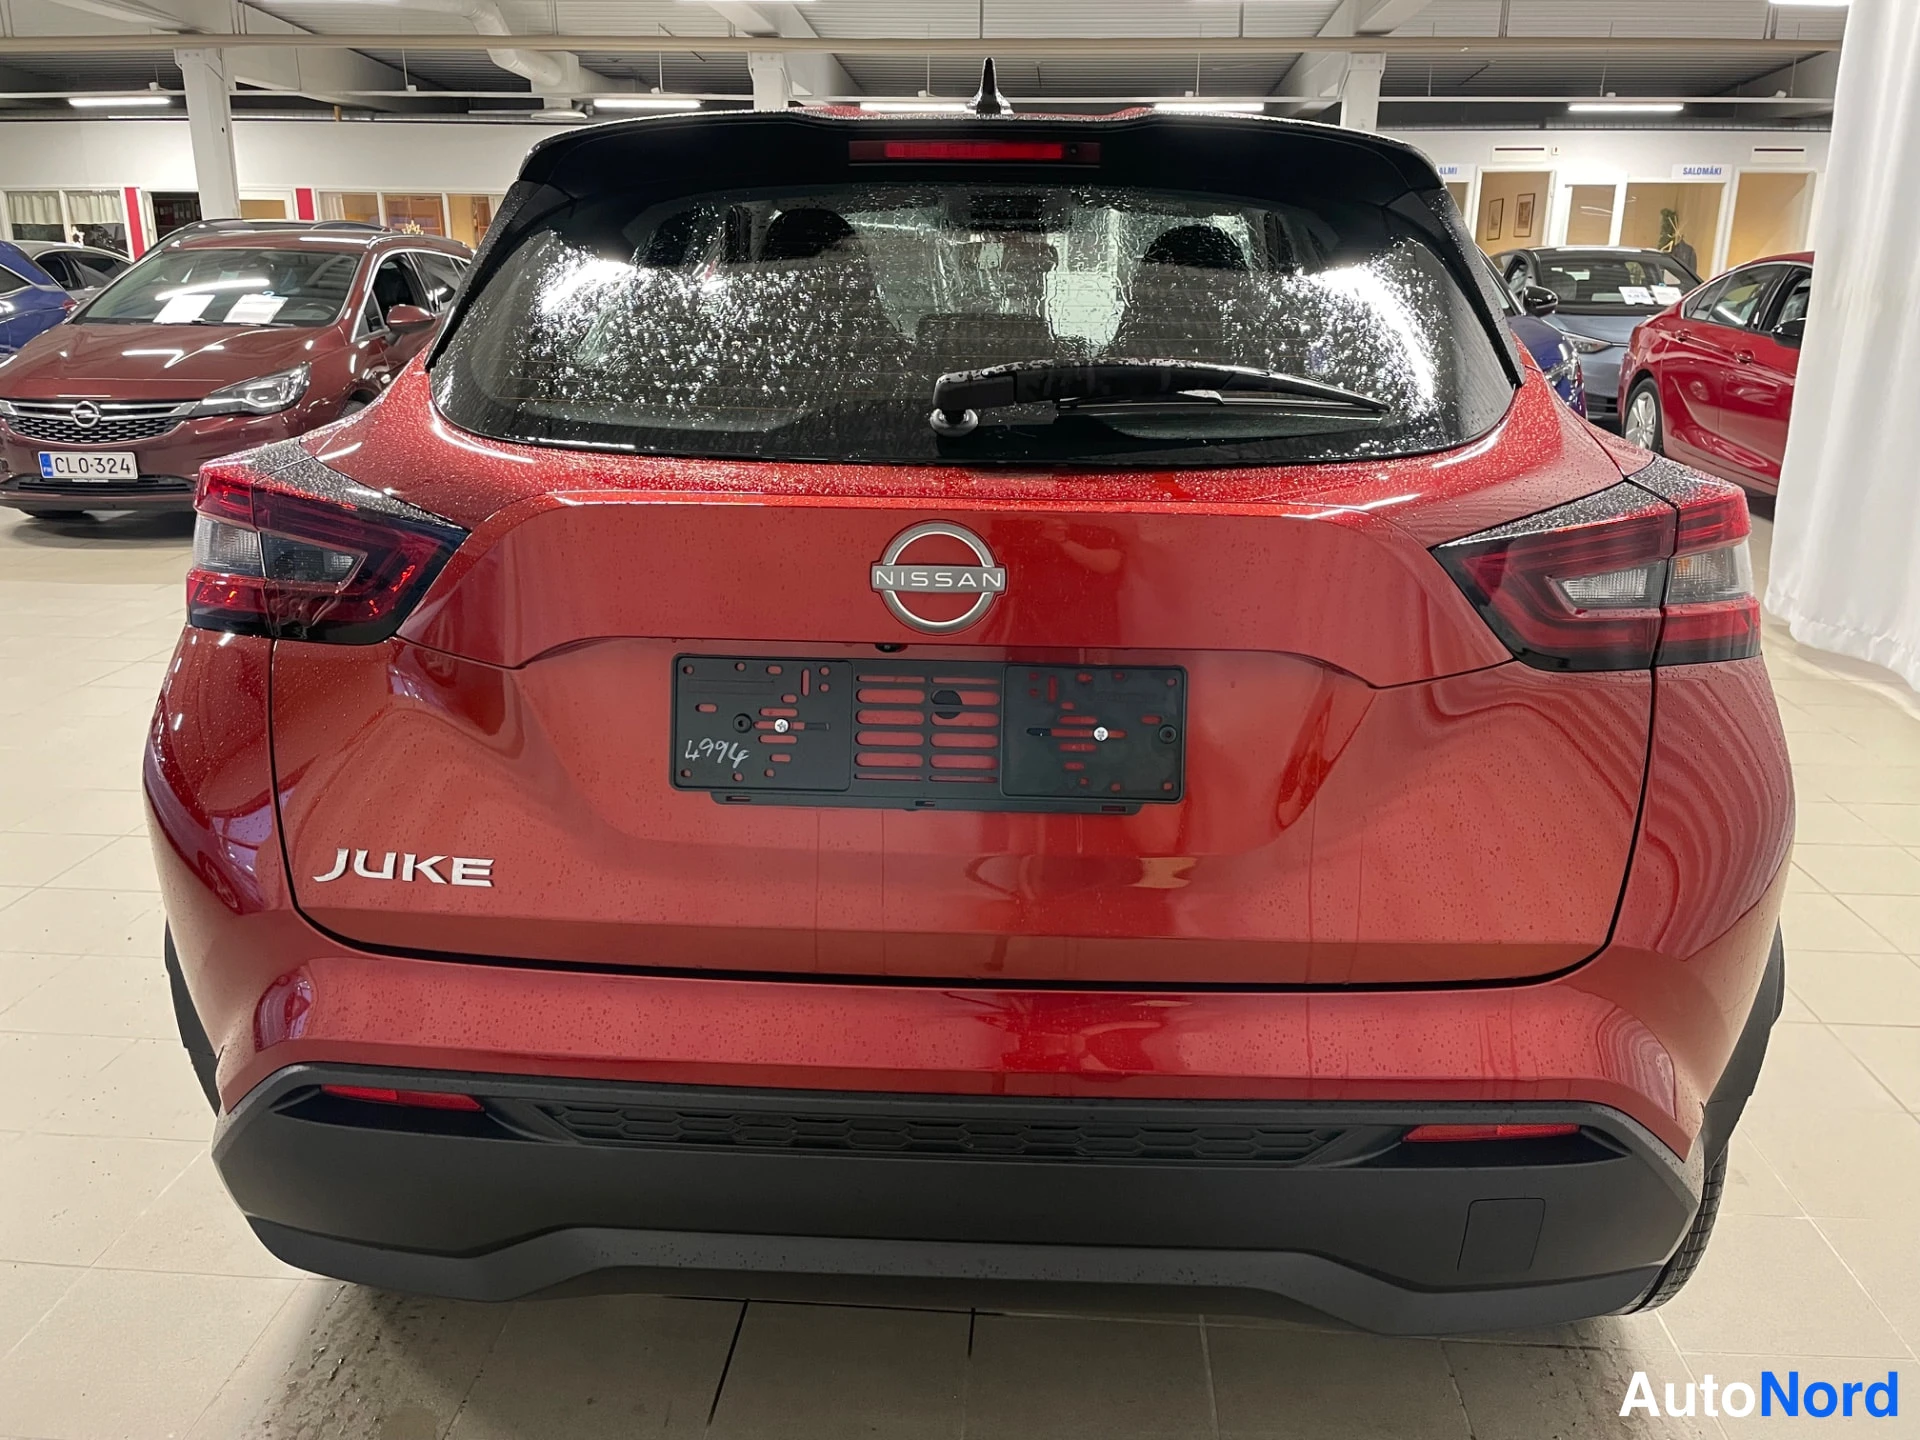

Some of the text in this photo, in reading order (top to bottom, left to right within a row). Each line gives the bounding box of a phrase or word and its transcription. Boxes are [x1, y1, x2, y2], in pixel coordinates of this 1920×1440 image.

[876, 570, 1001, 588] NISSAN
[685, 738, 750, 769] 4994
[312, 848, 495, 887] JUKE
